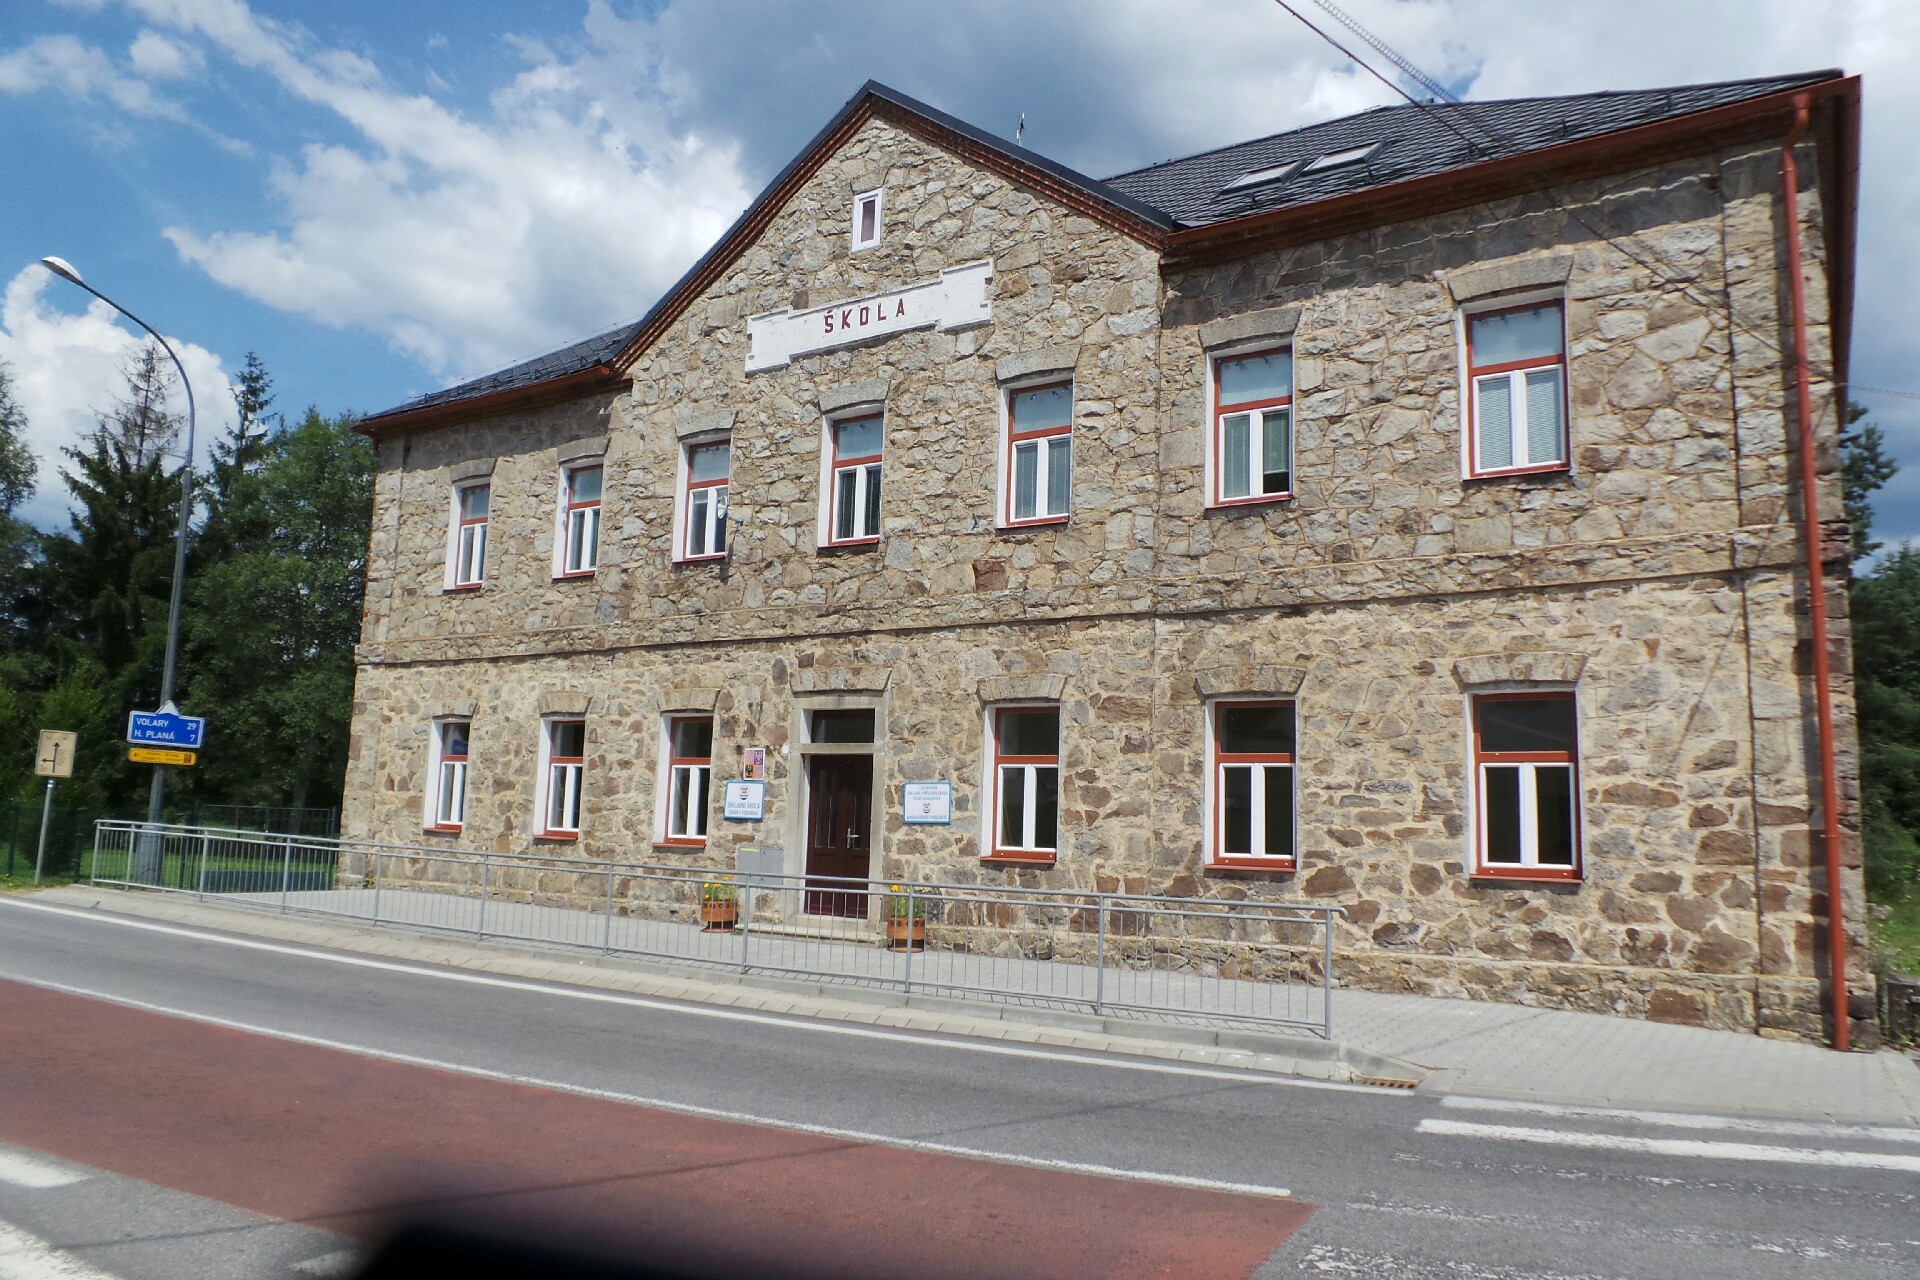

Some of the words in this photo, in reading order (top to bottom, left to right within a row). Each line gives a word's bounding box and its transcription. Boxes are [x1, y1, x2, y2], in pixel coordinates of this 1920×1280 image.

[823, 297, 906, 334] ŠKOLA
[136, 717, 169, 728] VOLARY
[186, 722, 197, 731] 29
[134, 729, 142, 738] H.
[145, 730, 175, 740] PLANÁ
[189, 734, 196, 742] 7
